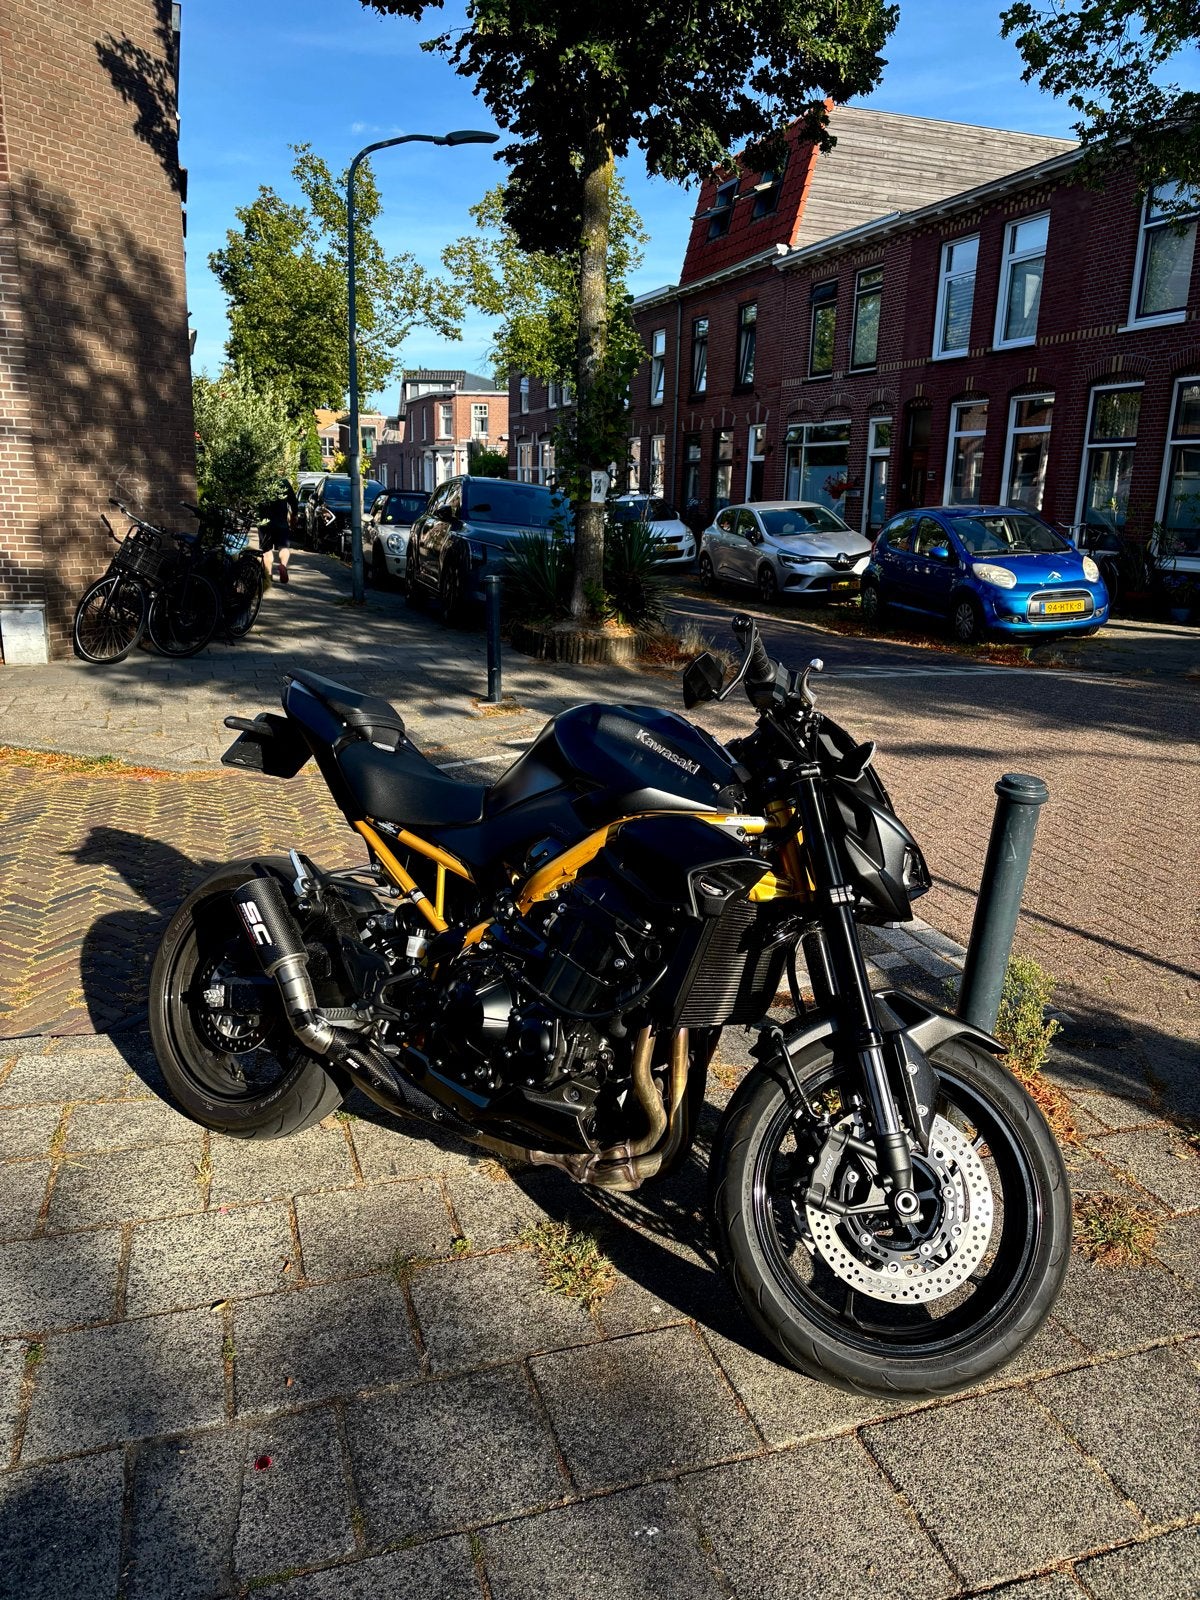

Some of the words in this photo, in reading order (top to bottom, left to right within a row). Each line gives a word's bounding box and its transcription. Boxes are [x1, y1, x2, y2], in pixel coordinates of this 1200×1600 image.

[1047, 602, 1082, 613] 94-HTK-8
[635, 728, 700, 775] Kawasaki
[241, 901, 273, 945] SC
